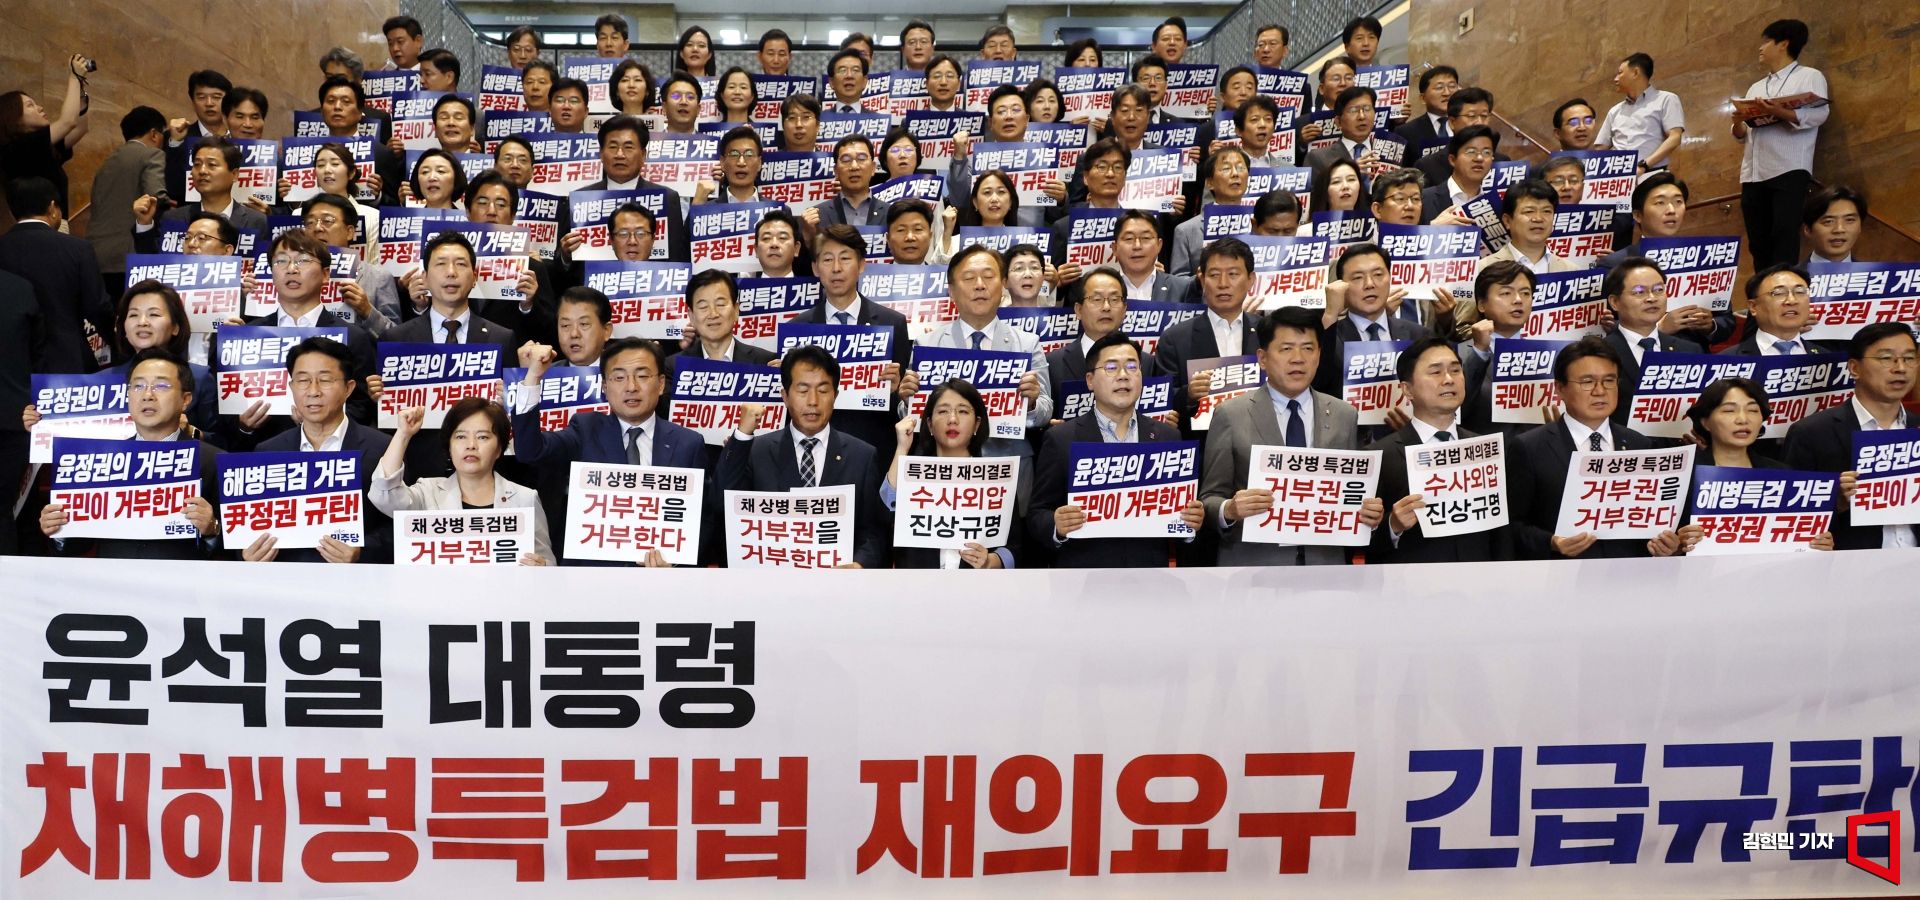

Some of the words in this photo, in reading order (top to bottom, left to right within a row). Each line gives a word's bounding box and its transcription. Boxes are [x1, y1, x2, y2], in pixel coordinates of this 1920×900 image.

[968, 67, 1014, 85] 해병특검
[1017, 63, 1040, 81] 거부
[1057, 75, 1094, 91] 윤정권의
[1097, 70, 1126, 89] 거부권
[1187, 66, 1217, 86] 거부권
[1278, 74, 1306, 93] 거부권
[1383, 67, 1408, 87] 거부
[1378, 90, 1407, 106] 규탄!
[393, 121, 423, 140] 국민이
[487, 119, 535, 137] 해병특검
[859, 118, 890, 137] 거부권
[1057, 127, 1086, 147] 거부권
[1165, 126, 1198, 144] 거부권
[245, 144, 275, 165] 거부
[572, 137, 600, 158] 거부
[690, 138, 719, 159] 거부
[974, 149, 1028, 171] 해병특검
[1029, 145, 1057, 167] 거부
[565, 161, 601, 183] 규탄!
[760, 161, 812, 181] 해병특검
[1147, 153, 1180, 173] 거부권
[1600, 155, 1636, 176] 거부권
[238, 167, 273, 188] 규탄!
[907, 177, 941, 197] 거부권
[1273, 171, 1309, 191] 거부권
[1589, 178, 1634, 199] 거부한다!
[531, 197, 559, 219] 거부권
[1583, 208, 1615, 230] 거부
[693, 208, 750, 237] 해병특검
[1315, 219, 1364, 241] 윤정권의
[484, 230, 528, 254] 거부권
[1068, 244, 1106, 265] 국민이
[1280, 240, 1327, 266] 거부권
[1434, 230, 1479, 255] 거부권
[1702, 240, 1739, 267] 거부권
[201, 261, 239, 284] 거부
[656, 267, 690, 290] 거부
[1263, 268, 1326, 295] 거부한다!
[1417, 259, 1476, 284] 거부한다!
[1683, 269, 1737, 296] 거부한다!
[1810, 270, 1889, 298] 해병특검
[788, 282, 821, 307] 거부
[861, 274, 926, 298] 해병특검
[1452, 288, 1474, 298] 민주당
[1562, 274, 1605, 303] 거부권
[191, 290, 238, 315] 규탄!
[1711, 299, 1728, 308] 민주당
[841, 331, 890, 359] 거부권
[381, 353, 447, 383] 윤정권의
[448, 349, 499, 378] 거부권
[977, 358, 1029, 386] 거부권
[1209, 362, 1262, 390] 병특검
[1496, 350, 1557, 378] 윤정권의
[1638, 362, 1708, 391] 윤정권의
[675, 370, 740, 397] 윤정권의
[1763, 362, 1833, 394] 윤정권의
[36, 383, 106, 415] 윤정권의
[862, 397, 886, 408] 민주당
[1346, 382, 1394, 413] 국민이
[1495, 384, 1534, 411] 국민이
[671, 403, 716, 430] 국민이
[1632, 397, 1682, 424] 국민이
[996, 425, 1022, 435] 민주당
[55, 452, 132, 484] 윤정권의
[134, 447, 196, 480] 거부권
[1267, 453, 1283, 471] 채
[1286, 453, 1320, 472] 상병
[1322, 455, 1369, 475] 특검법
[1417, 448, 1462, 467] 특검법
[1463, 441, 1501, 461] 재의결로
[1587, 458, 1604, 474] 채
[1606, 456, 1638, 474] 상병
[1640, 453, 1684, 472] 특검법
[223, 463, 309, 497] 해병특검
[313, 457, 356, 488] 거부
[906, 463, 954, 480] 특검법
[956, 464, 1012, 481] 재의결로
[1072, 453, 1143, 487] 윤정권의
[1145, 447, 1197, 481] 거부권
[586, 470, 602, 487] 채
[605, 471, 637, 489] 상병
[640, 473, 688, 492] 특검법
[1264, 476, 1367, 506] 거부권을
[1423, 463, 1499, 498] 수사외압
[1579, 476, 1682, 503] 거부권을
[740, 497, 755, 513] 채
[758, 497, 790, 515] 상병
[793, 497, 840, 515] 특검법
[909, 485, 1008, 511] 수사외압
[1124, 483, 1196, 518] 거부한다!
[1696, 480, 1786, 510] 해병특검
[1786, 479, 1835, 508] 거부
[1854, 479, 1907, 511] 국민이
[223, 498, 298, 534] 尹정권
[303, 492, 359, 526] 규탄!
[583, 493, 688, 523] 거부권을
[1259, 506, 1361, 535] 거부한다
[1425, 492, 1501, 526] 진상규명
[1573, 504, 1677, 530] 거부한다
[164, 525, 197, 535] 민주당
[411, 517, 428, 535] 채
[431, 516, 465, 535] 상병
[468, 515, 518, 534] 특검법
[579, 523, 687, 552] 거부한다
[740, 518, 841, 545] 거부권을
[909, 513, 1002, 540] 진상규명
[1696, 515, 1767, 544] 尹정권
[1769, 514, 1830, 543] 규탄!
[411, 539, 520, 565] 거부권을
[740, 543, 842, 569] 거부한다
[42, 612, 385, 728] 윤석열
[428, 620, 756, 728] 대통령
[20, 751, 808, 883] 채해병특검법
[856, 750, 1357, 879] 재의요구
